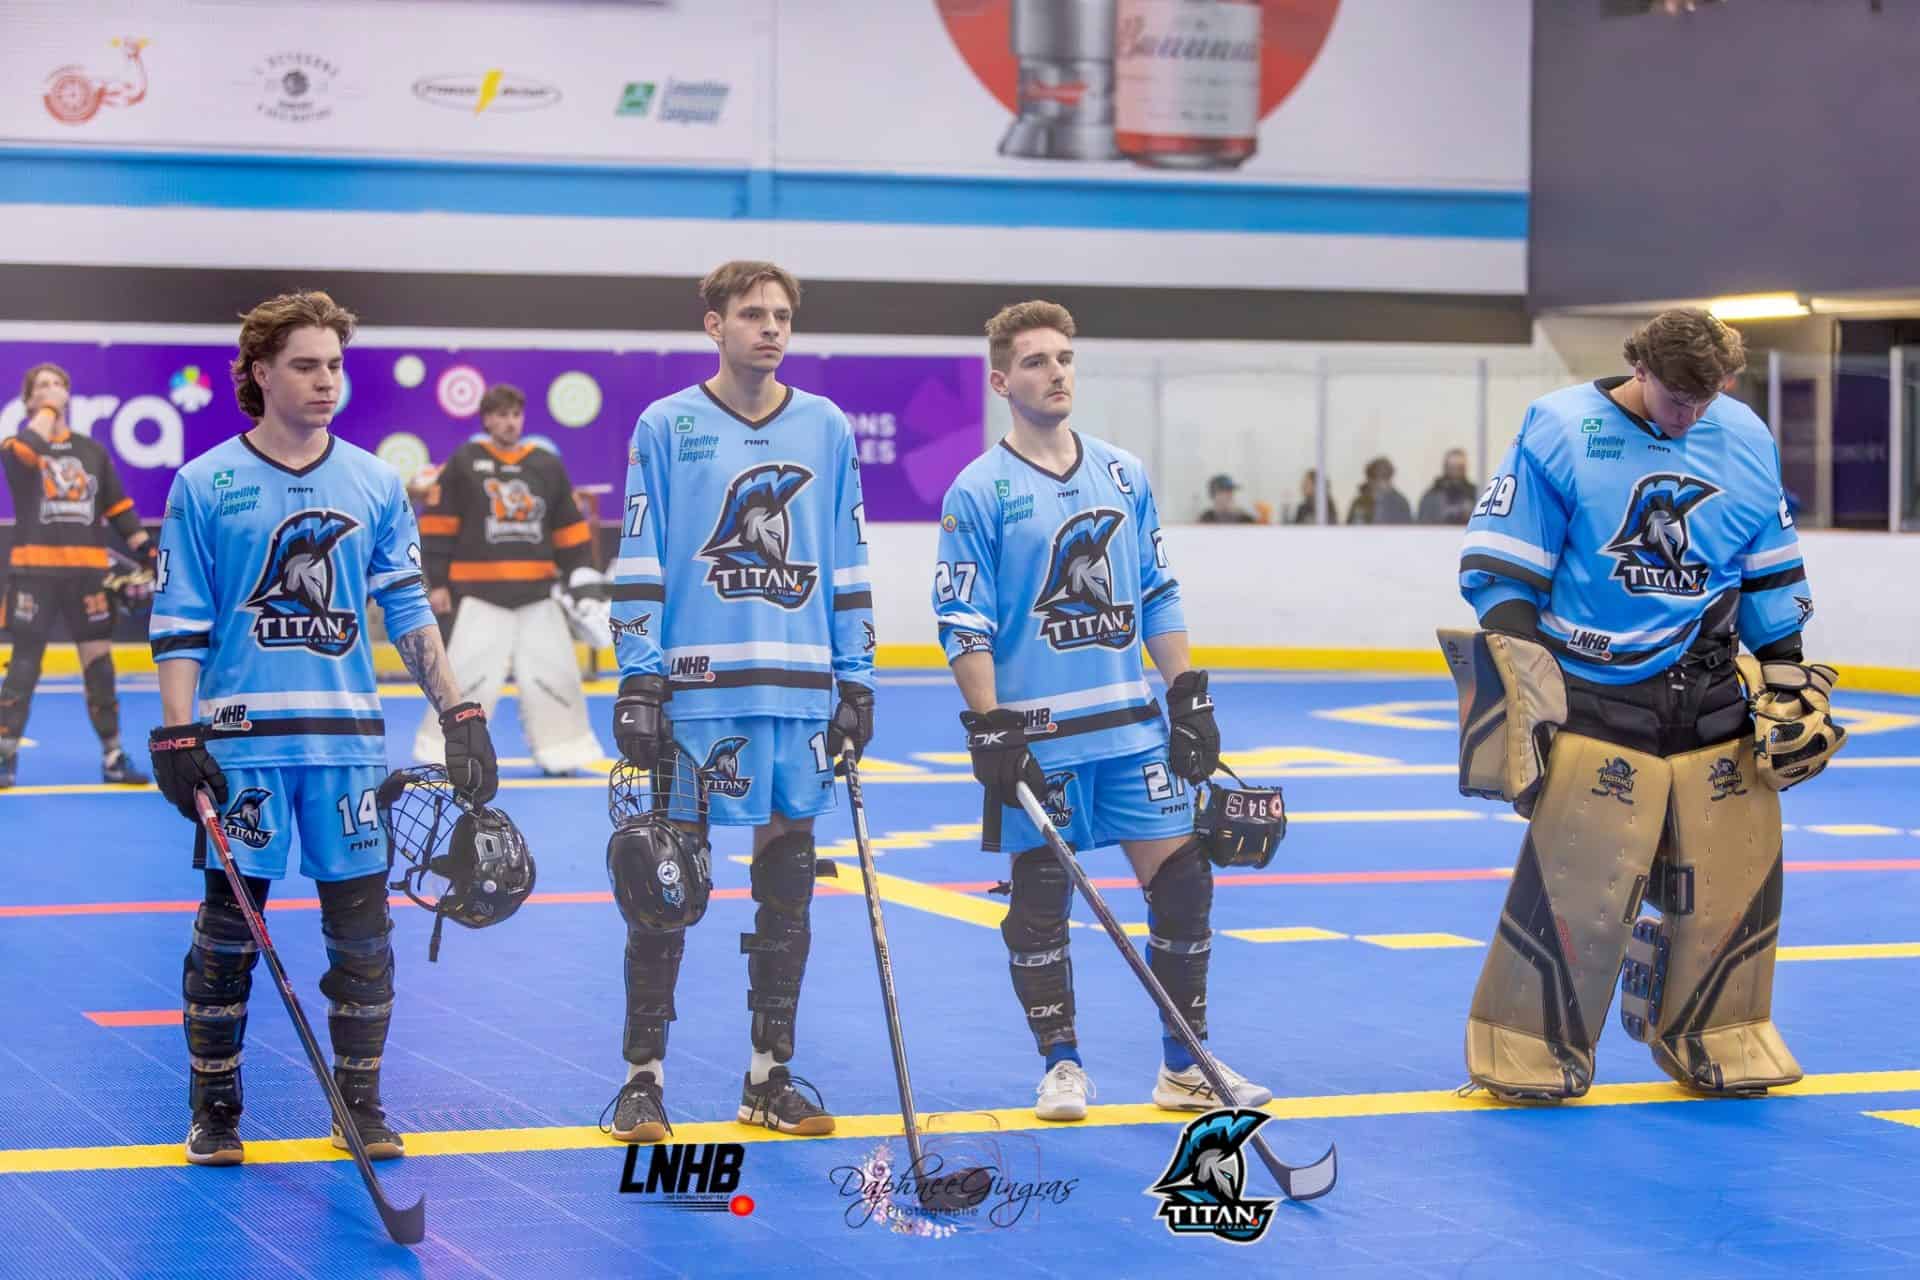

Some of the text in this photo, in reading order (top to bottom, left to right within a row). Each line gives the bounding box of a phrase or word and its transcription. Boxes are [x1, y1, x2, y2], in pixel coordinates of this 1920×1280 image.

[1472, 474, 1518, 518] 29
[621, 493, 648, 538] 7
[715, 567, 801, 590] TITAN
[935, 561, 977, 604] 27
[1623, 565, 1699, 588] TITAN
[259, 616, 345, 638] TITAN
[1047, 610, 1126, 641] TITAN
[1569, 629, 1611, 651] LNHB
[671, 656, 710, 676] LNHB
[214, 704, 247, 724] LNHB
[337, 788, 378, 837] 14
[227, 824, 266, 842] TITAN
